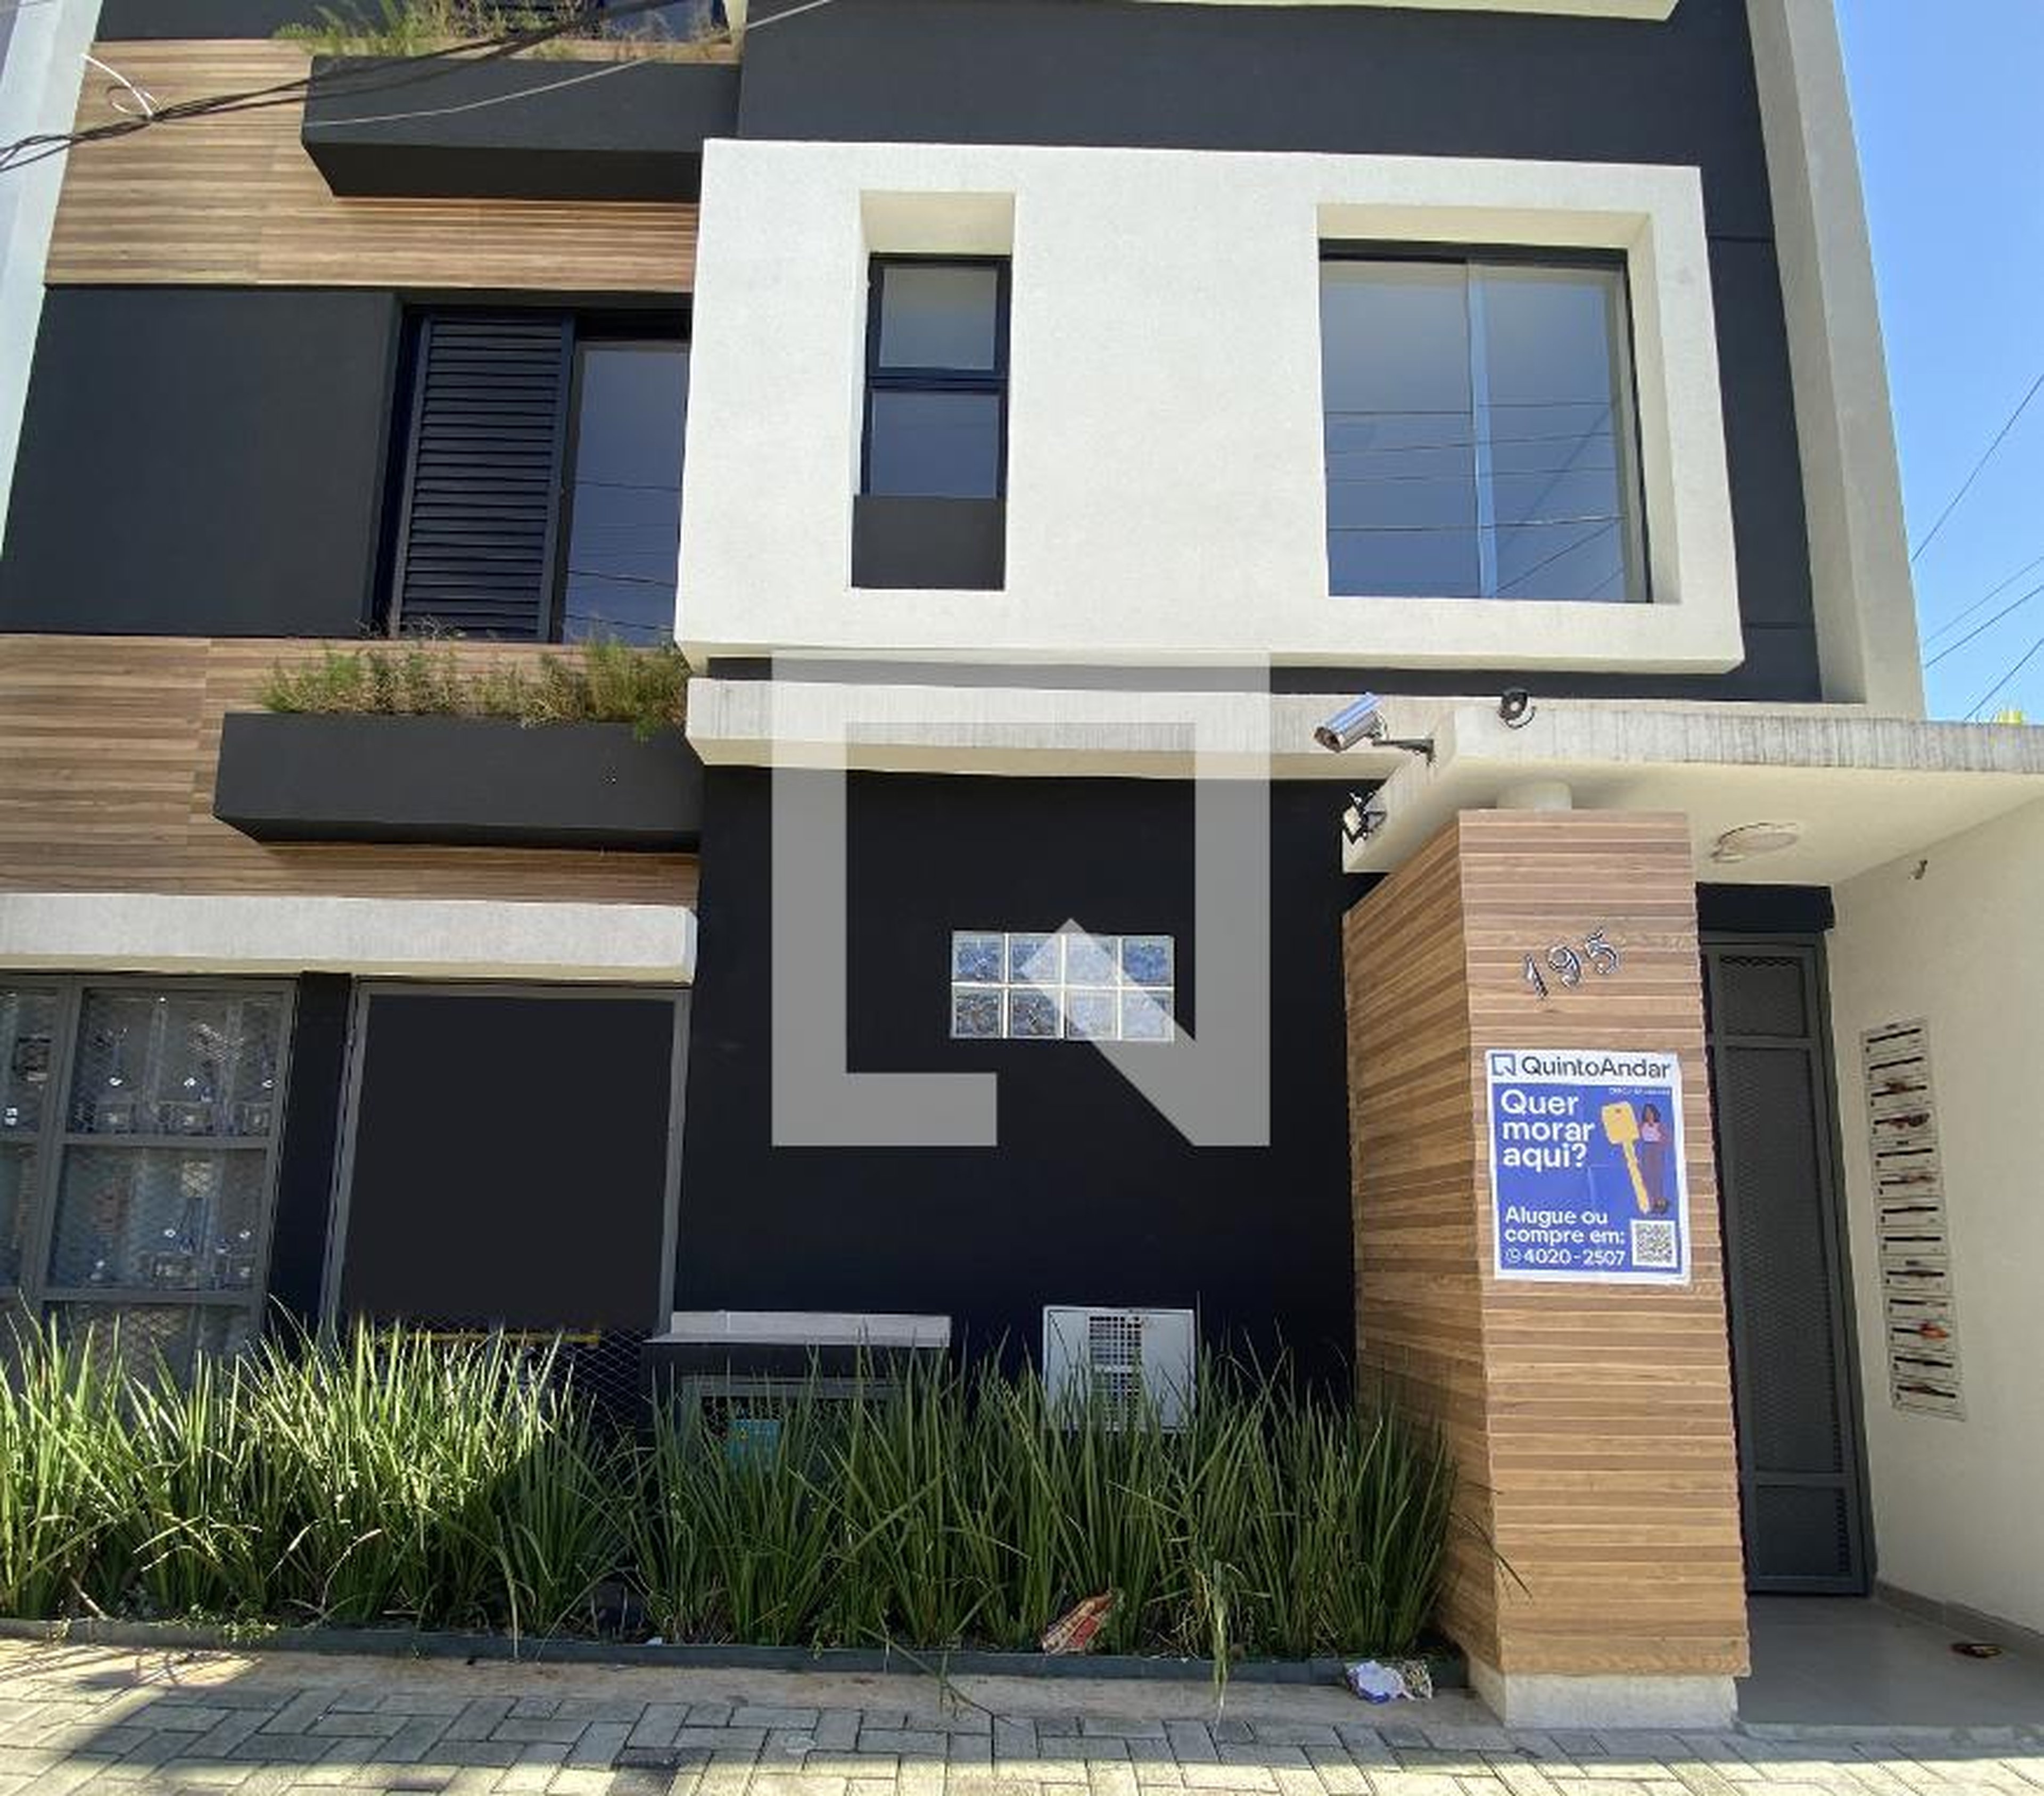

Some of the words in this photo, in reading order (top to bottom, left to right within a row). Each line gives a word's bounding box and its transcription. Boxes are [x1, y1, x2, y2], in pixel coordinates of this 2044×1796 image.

[1524, 927, 1618, 999] 195
[1521, 1056, 1670, 1078] QuintoAndar
[1501, 1089, 1579, 1115] Quer
[1502, 1122, 1595, 1142] morar
[1503, 1143, 1587, 1173] aqui?
[1504, 1206, 1577, 1227] Alugue
[1582, 1212, 1608, 1224] ou
[1505, 1230, 1585, 1247] compre
[1589, 1231, 1626, 1245] em:
